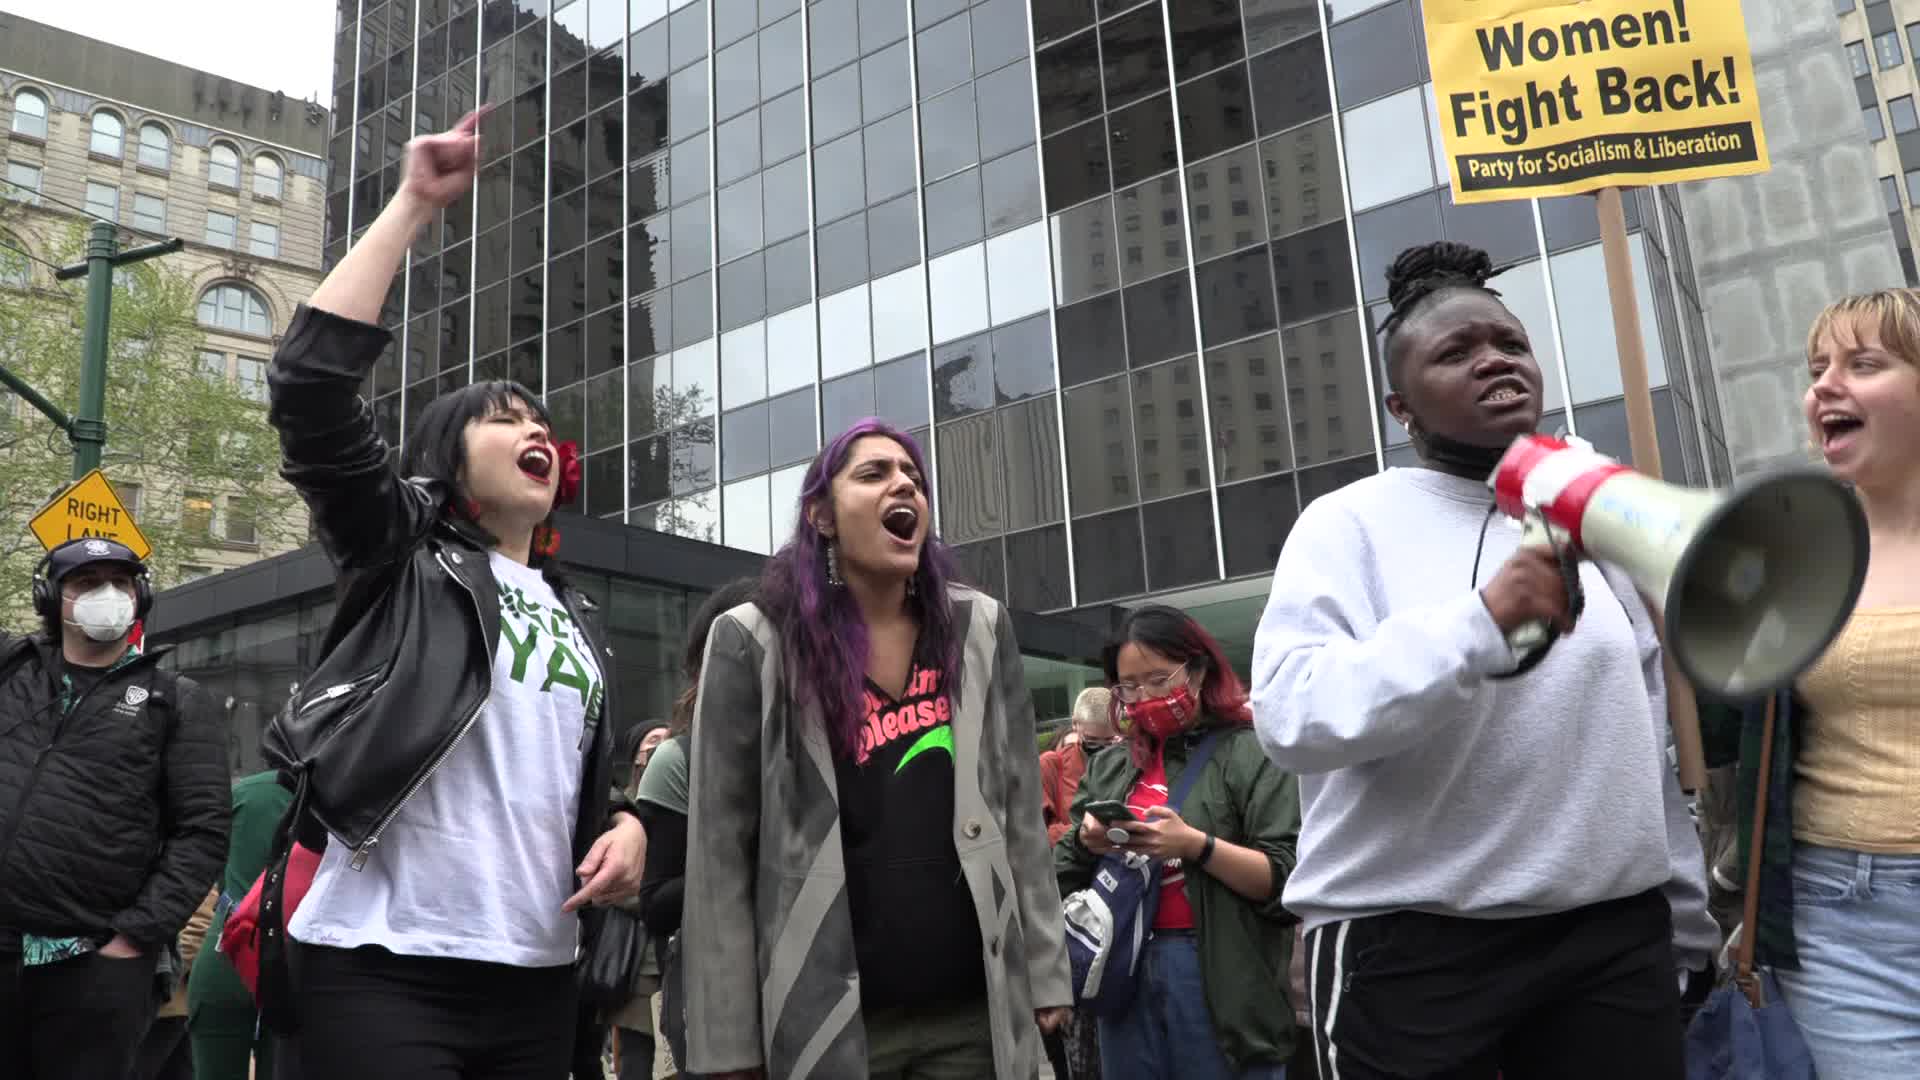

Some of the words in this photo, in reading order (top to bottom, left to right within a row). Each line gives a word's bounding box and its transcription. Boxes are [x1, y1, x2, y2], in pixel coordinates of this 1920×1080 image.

[1475, 0, 1690, 72] Women!
[1449, 74, 1583, 146] Fight
[1595, 56, 1741, 116] Back!
[1468, 158, 1514, 181] Party
[1517, 154, 1543, 176] for
[1545, 139, 1631, 172] Socialism
[1633, 138, 1647, 160] &
[1648, 131, 1742, 159] Liberation
[66, 523, 119, 540] LA
[67, 498, 121, 526] RIGHT
